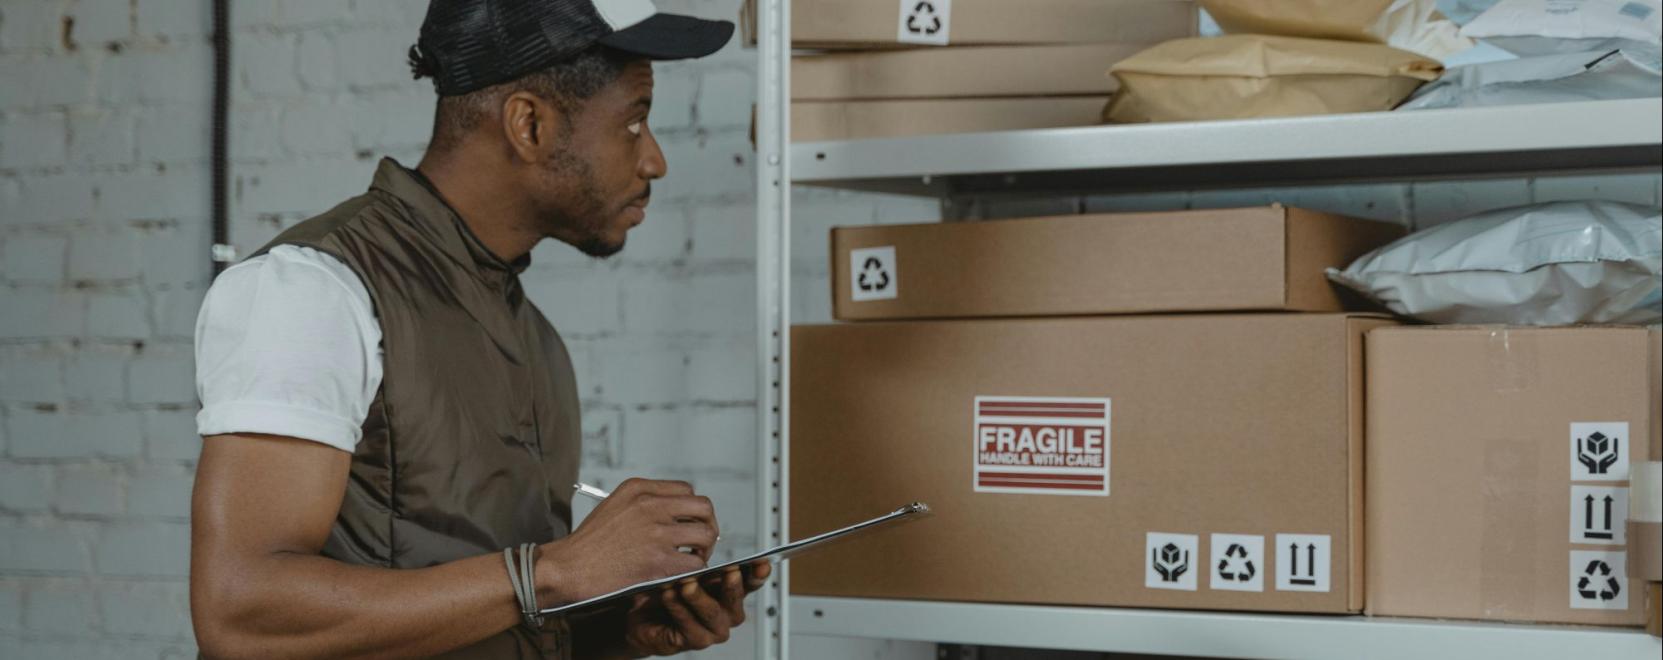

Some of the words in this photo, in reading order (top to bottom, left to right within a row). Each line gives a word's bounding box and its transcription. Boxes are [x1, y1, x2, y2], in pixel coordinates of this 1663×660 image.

[979, 427, 1103, 454] FRAGILE
[980, 452, 1030, 465] HANDLE
[1032, 453, 1064, 466] WITH
[1066, 454, 1102, 467] CARE
